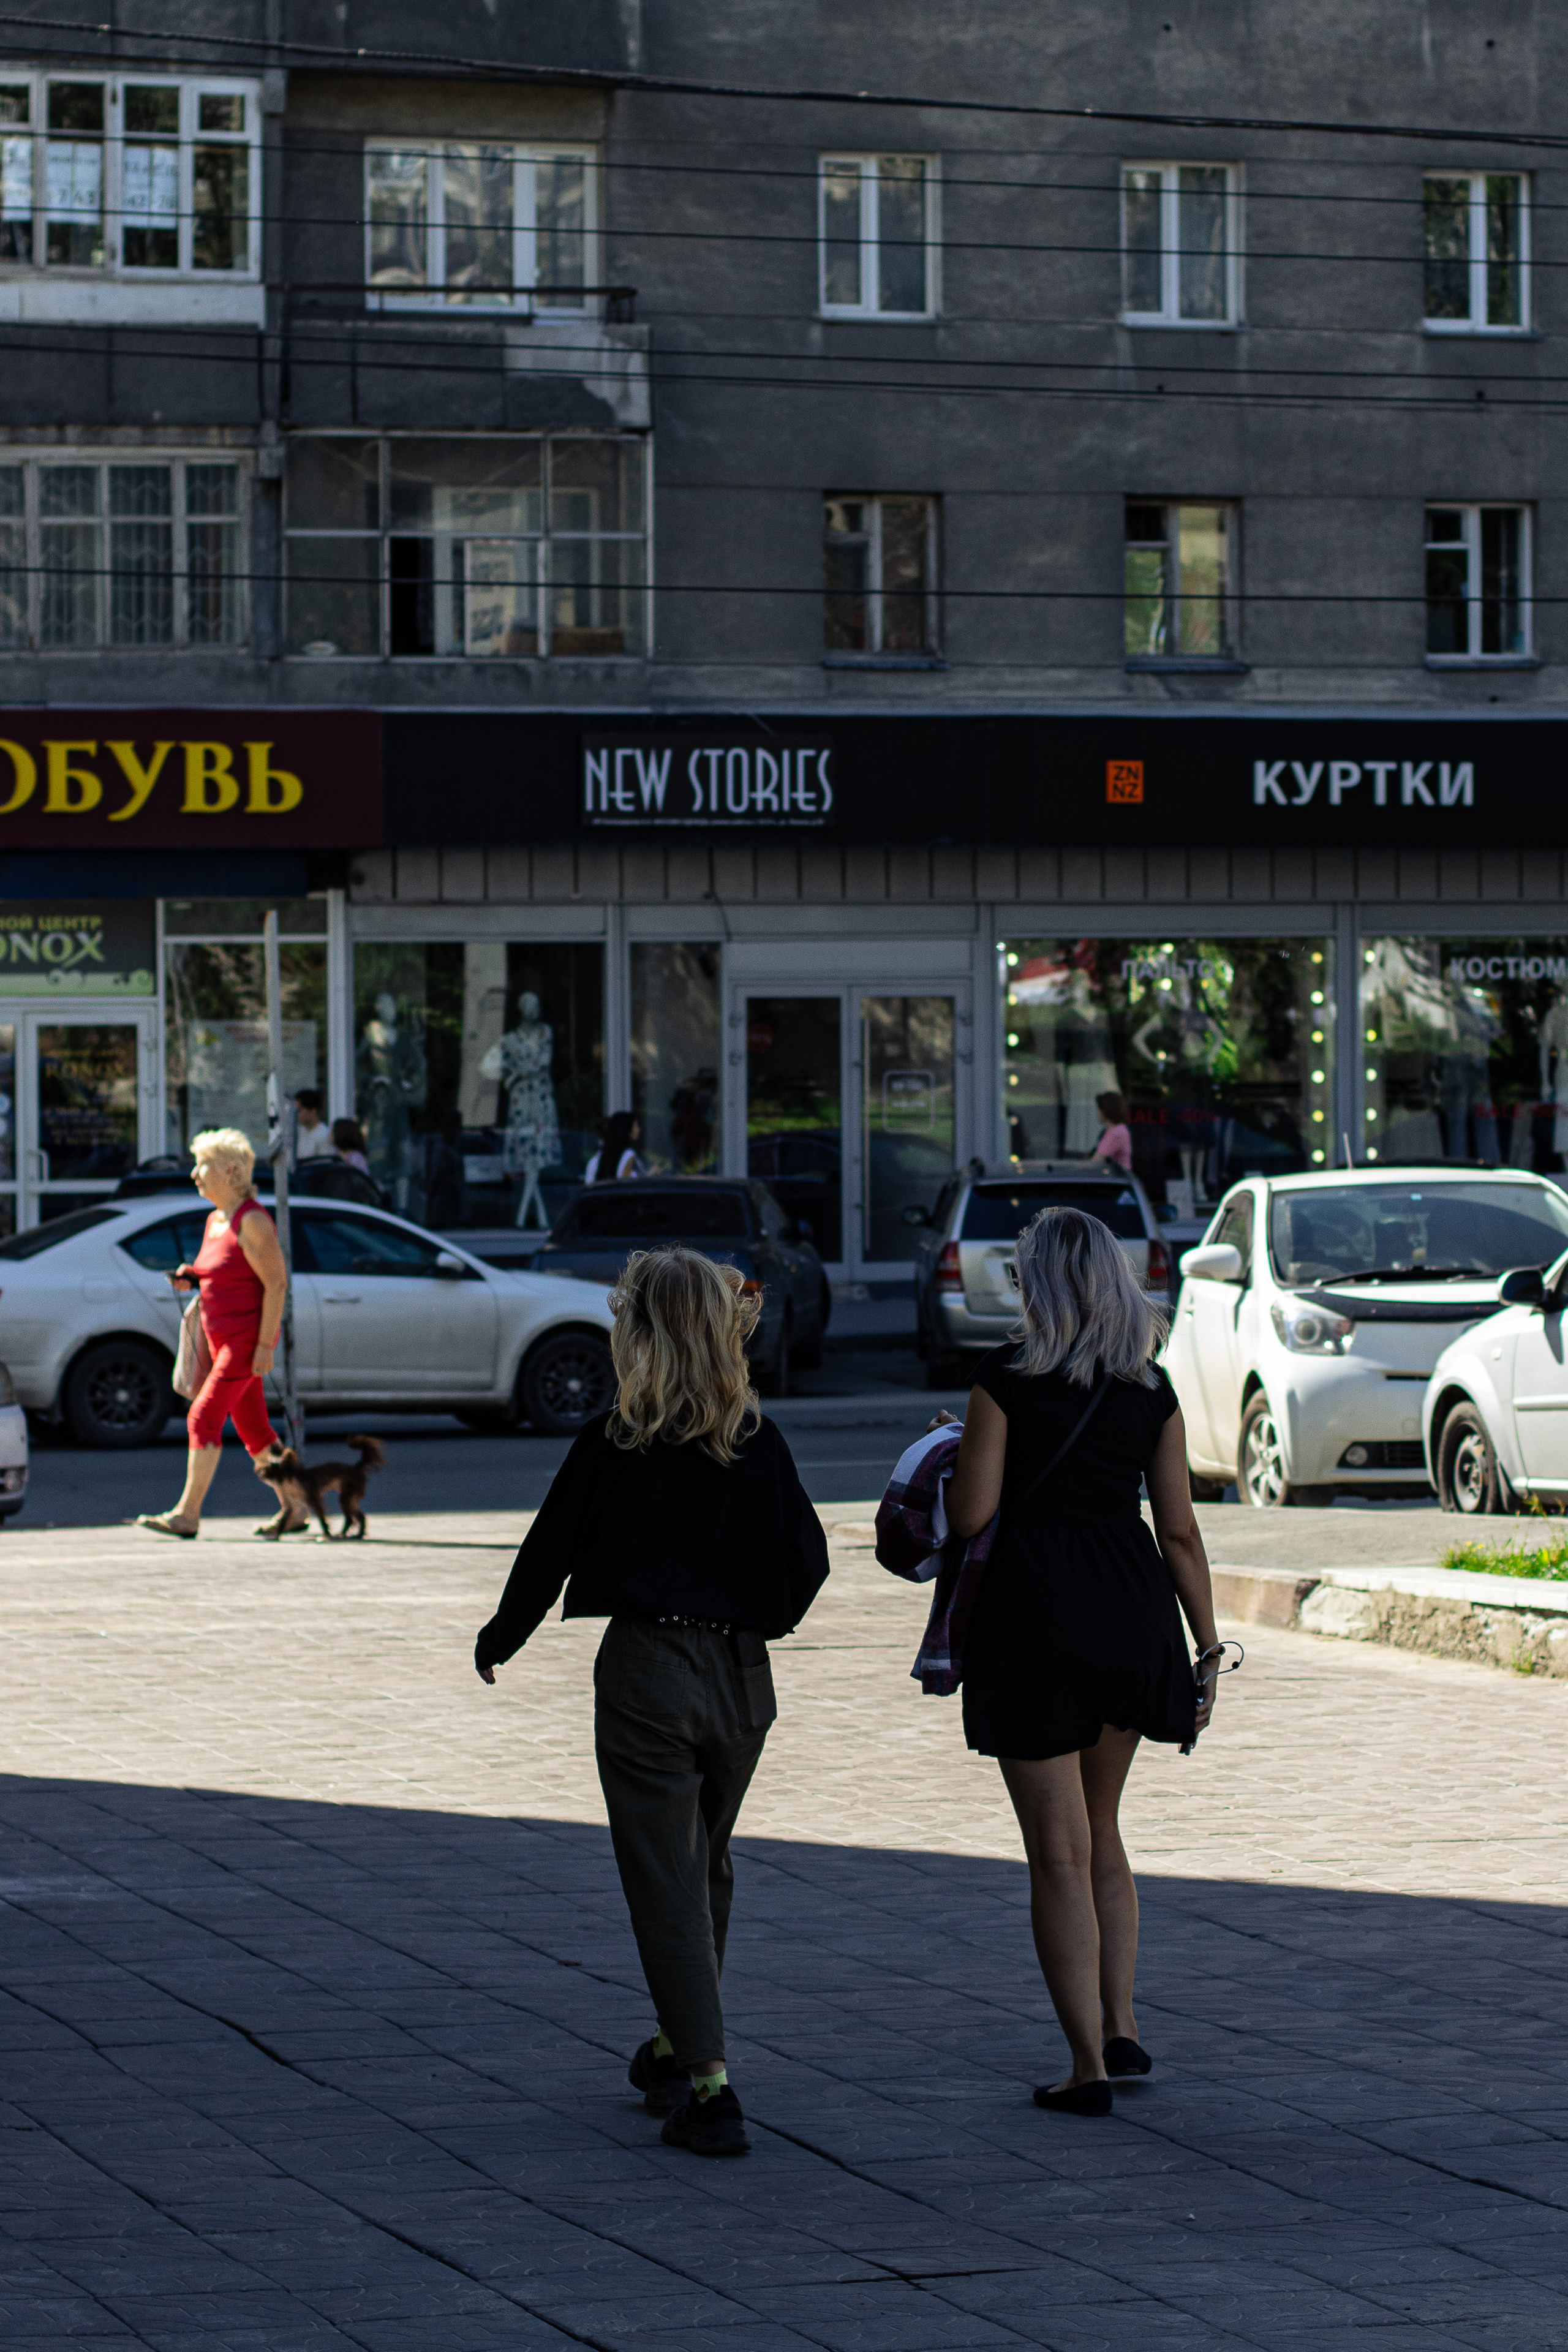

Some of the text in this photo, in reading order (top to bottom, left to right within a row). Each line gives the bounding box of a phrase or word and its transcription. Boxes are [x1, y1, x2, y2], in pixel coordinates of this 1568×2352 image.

[584, 746, 834, 814] NEW STORIES
[1114, 764, 1139, 781] ZN
[1253, 760, 1475, 807] КУРТКИ
[1113, 782, 1139, 798] NZ
[38, 914, 103, 931] ЦЕНТР
[0, 931, 105, 968] NOX
[1121, 959, 1214, 979] ПАЛЬТО
[1449, 956, 1566, 980] КОСТЮМ
